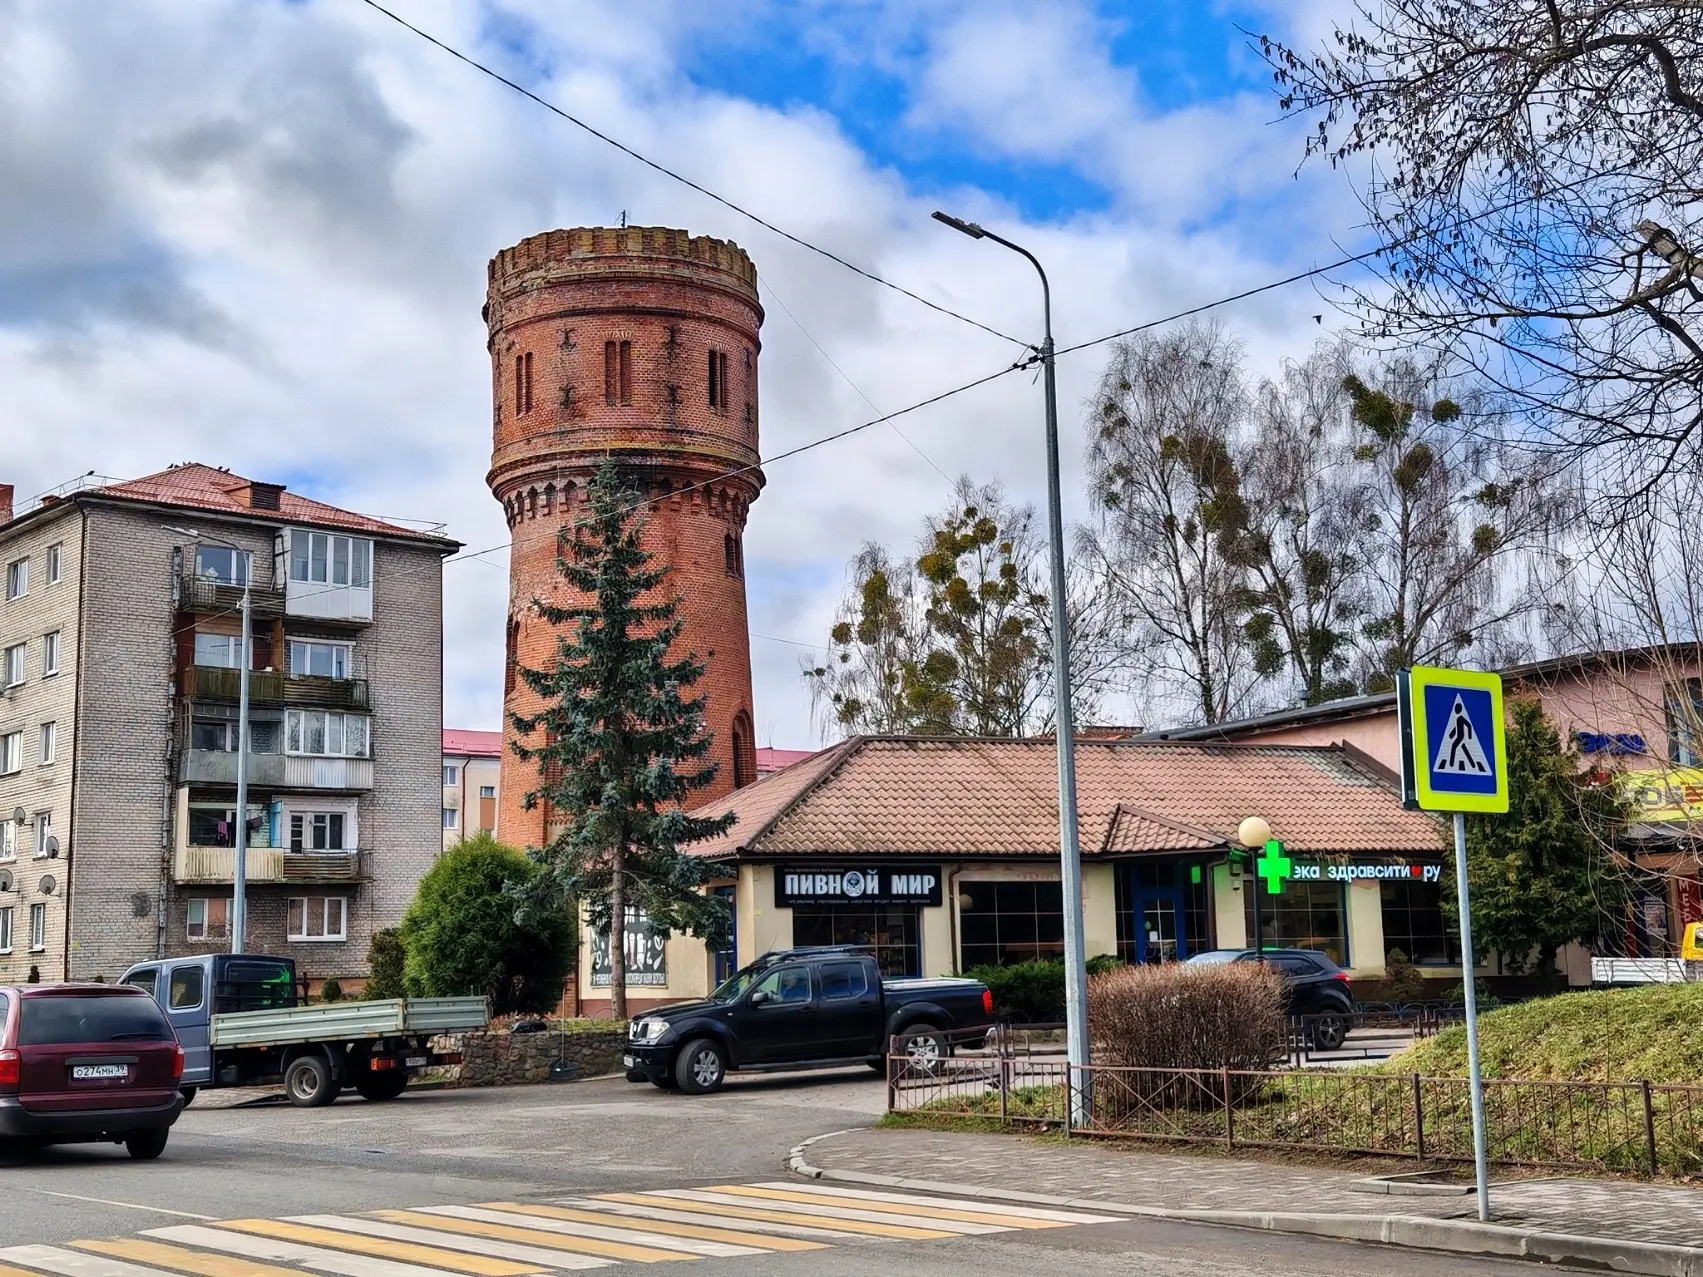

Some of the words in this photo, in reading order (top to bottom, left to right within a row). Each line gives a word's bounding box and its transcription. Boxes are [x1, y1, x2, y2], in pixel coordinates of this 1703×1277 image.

[785, 869, 879, 897] ПИВНОЙ
[891, 874, 935, 895] МИР
[1678, 879, 1692, 922] МЕБ
